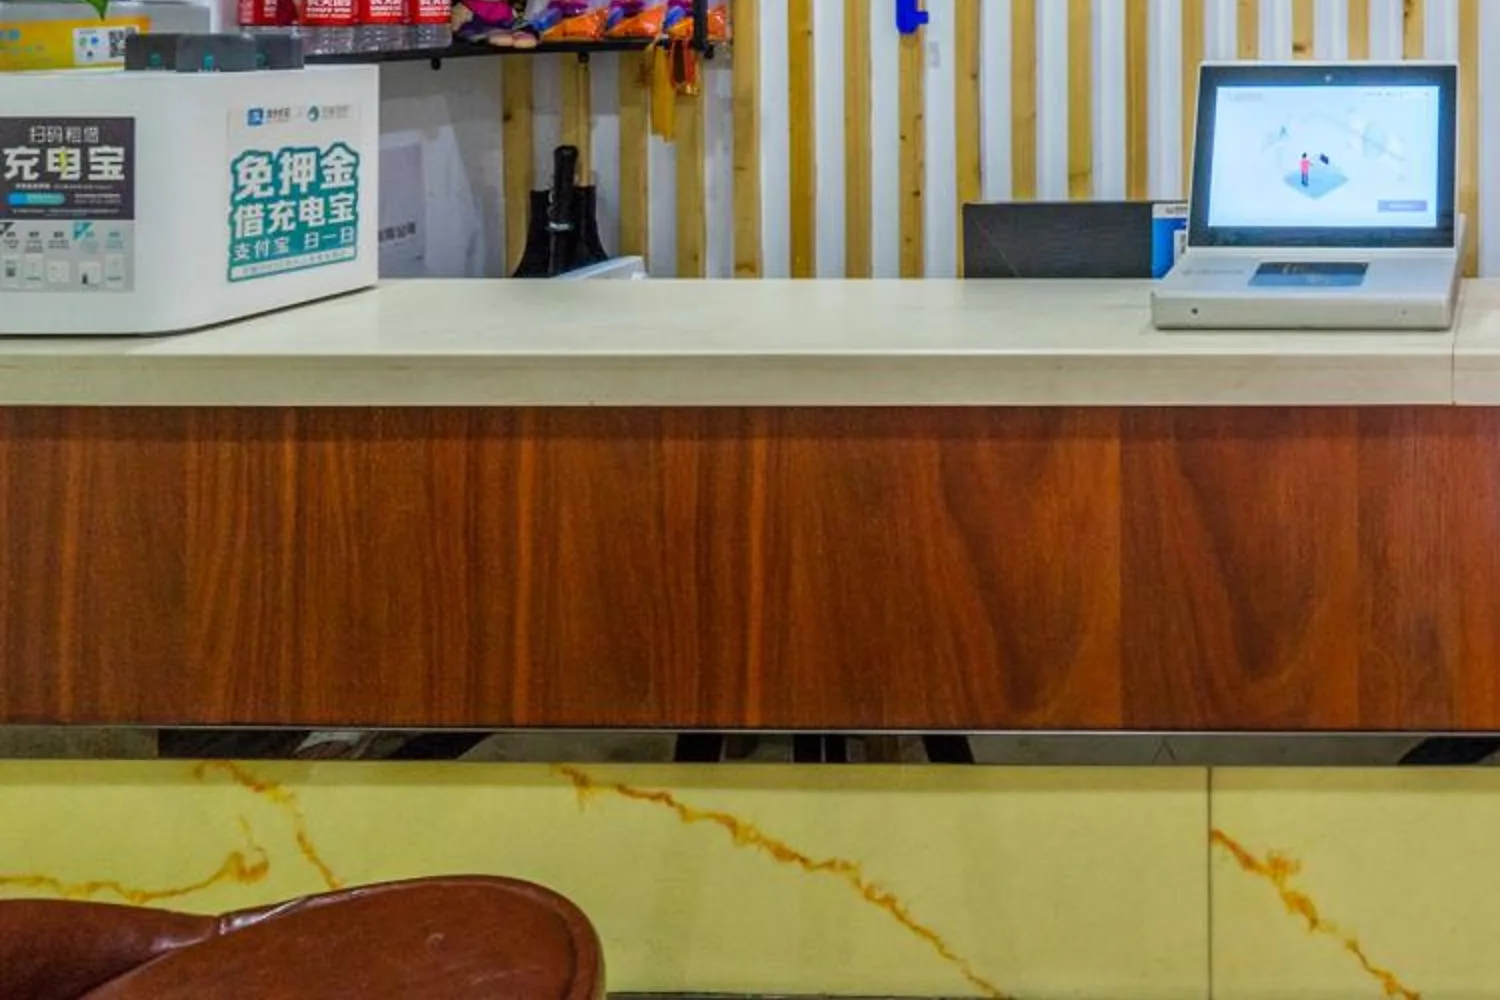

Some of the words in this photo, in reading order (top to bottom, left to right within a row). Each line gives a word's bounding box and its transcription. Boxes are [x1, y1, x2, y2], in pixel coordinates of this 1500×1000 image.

[3, 145, 125, 181] 充电宝
[233, 145, 355, 200] 免押金
[233, 192, 355, 238] 借充电宝
